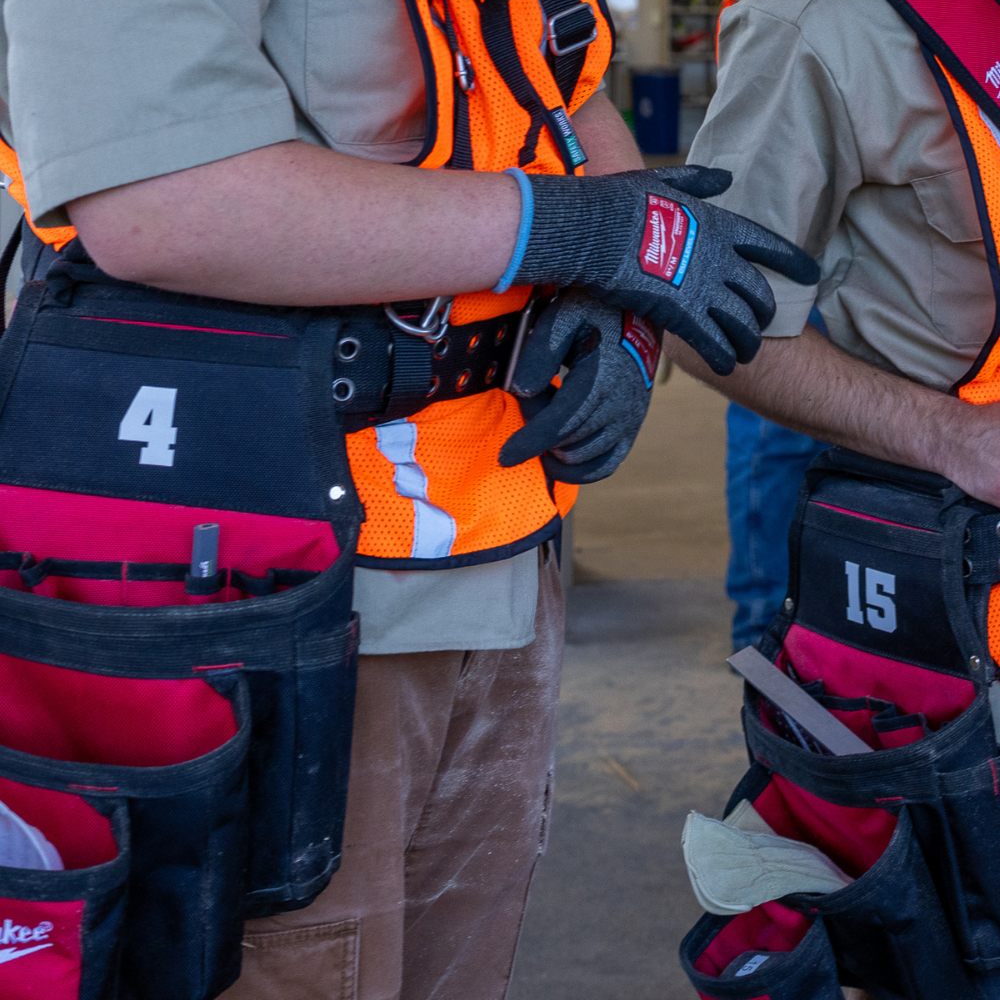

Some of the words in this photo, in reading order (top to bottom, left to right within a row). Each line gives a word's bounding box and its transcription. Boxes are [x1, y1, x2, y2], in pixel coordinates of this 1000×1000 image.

[644, 210, 660, 265] Milwaukee
[117, 385, 178, 467] 4
[845, 560, 897, 634] 15
